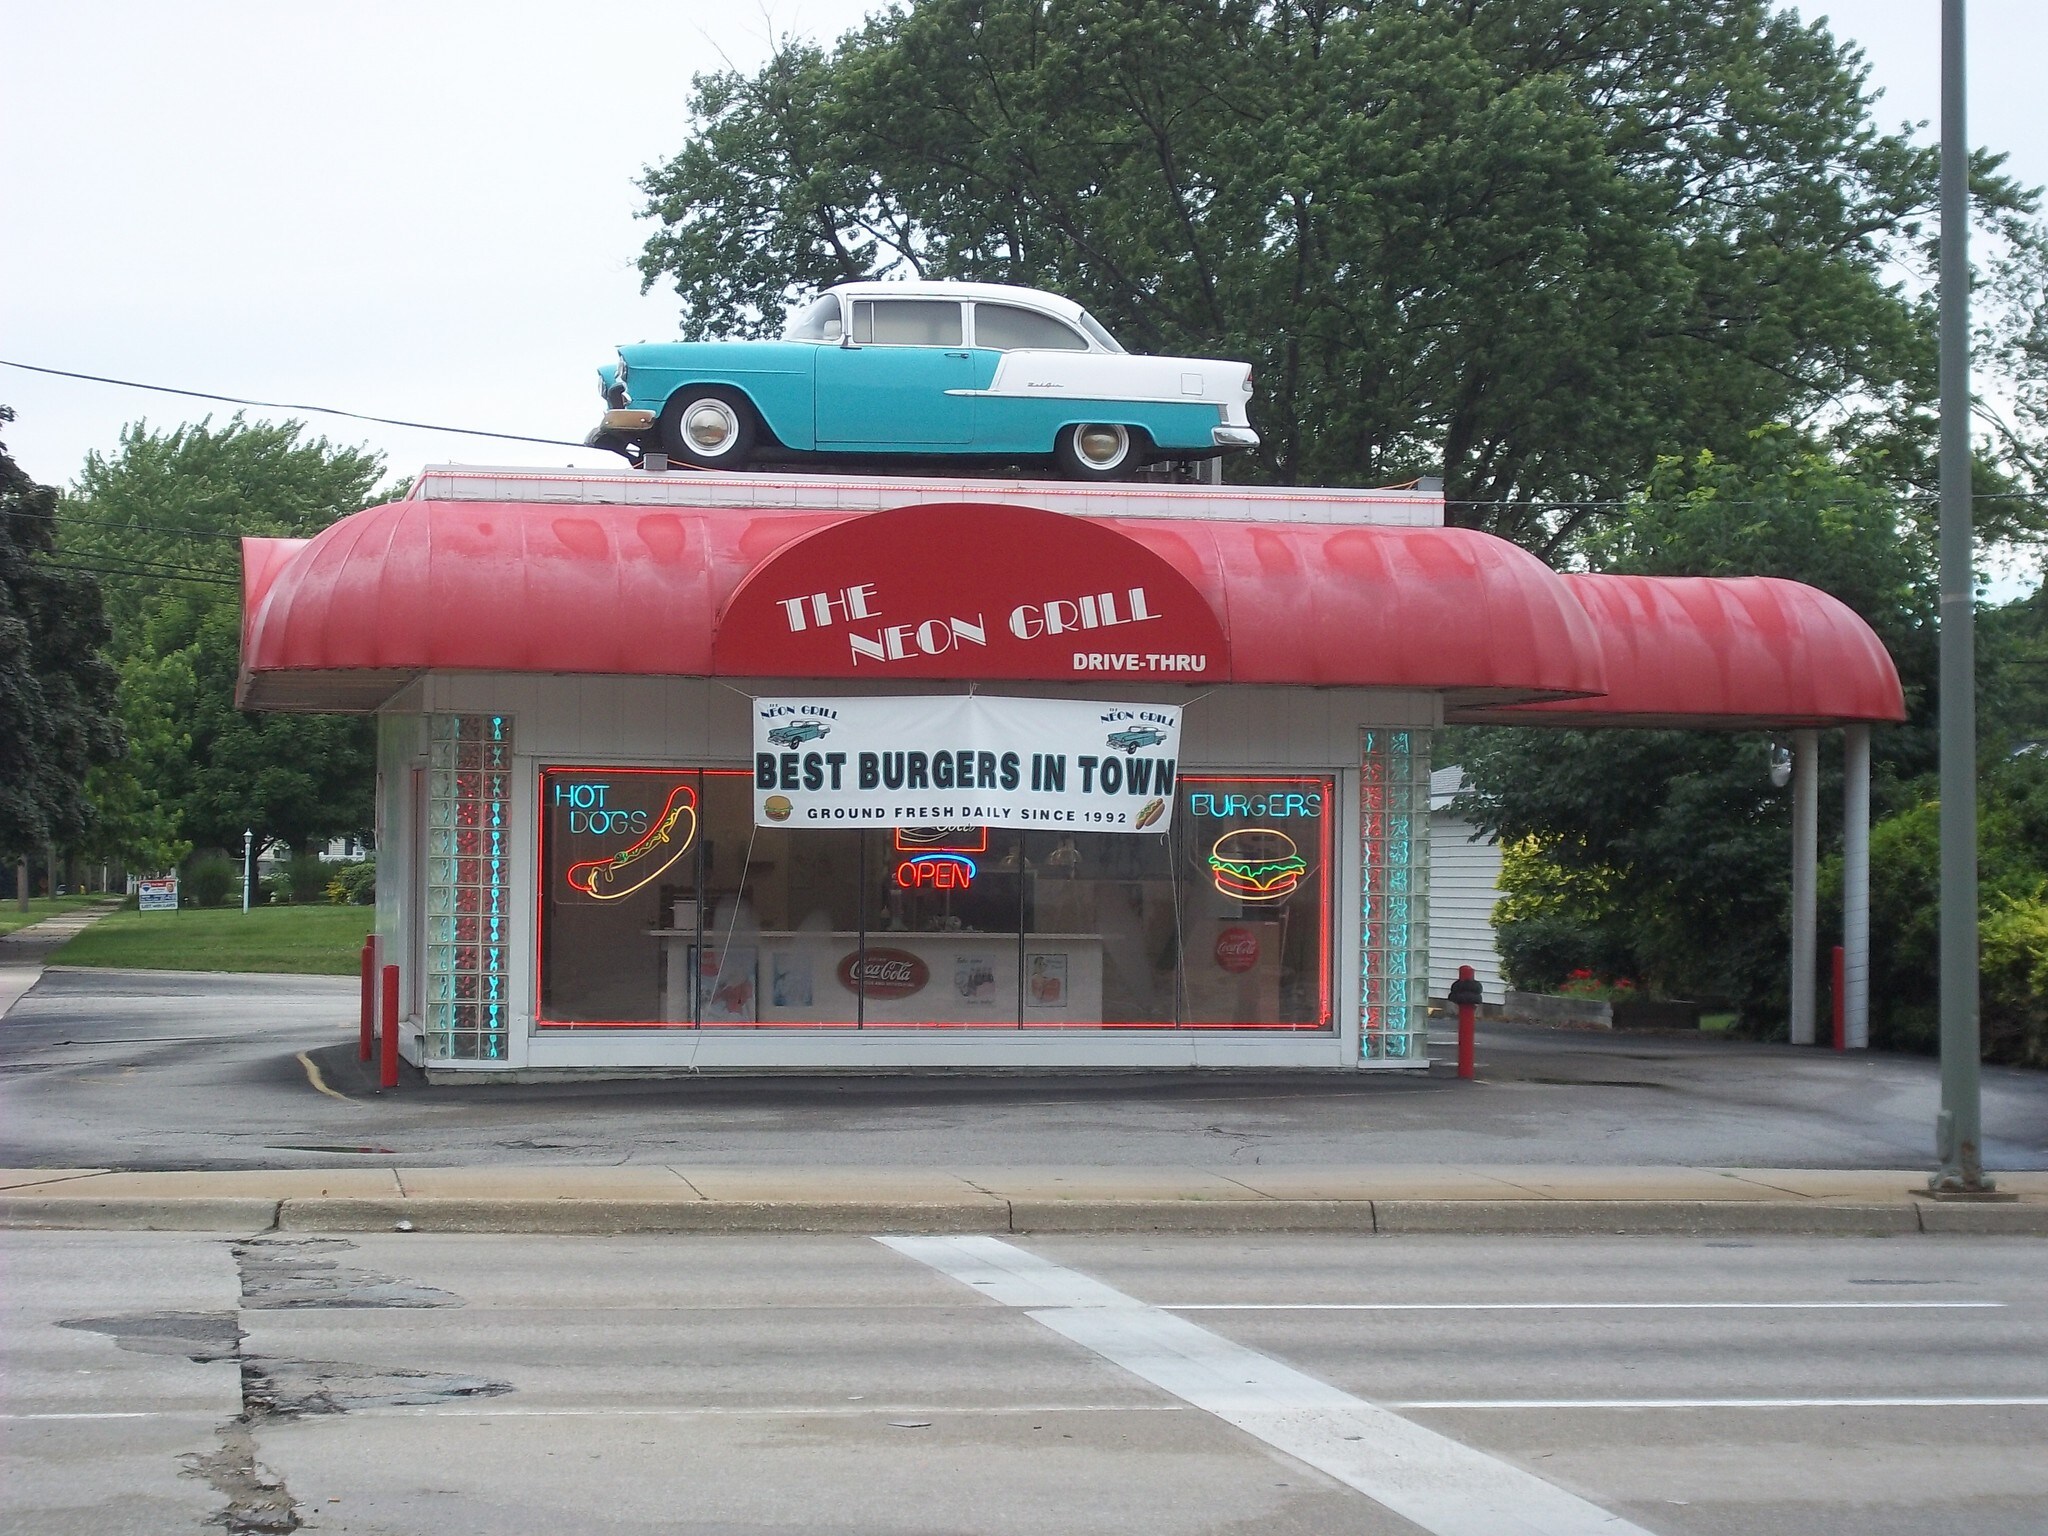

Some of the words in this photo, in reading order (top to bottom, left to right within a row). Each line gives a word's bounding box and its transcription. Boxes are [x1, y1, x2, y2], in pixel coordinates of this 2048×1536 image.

[776, 582, 882, 633] THE
[849, 612, 987, 667] NEON
[1009, 587, 1162, 640] GRILL
[1073, 653, 1206, 672] DRIVE-THRU
[760, 706, 796, 719] NEON
[801, 705, 839, 720] GRILL
[1100, 711, 1134, 724] NEON
[1140, 711, 1175, 728] GRILL
[756, 751, 847, 791] BEST
[858, 750, 1020, 791] BURGERS
[1031, 753, 1066, 792] IN
[1078, 756, 1175, 796] TOWN
[555, 784, 610, 808] HOT
[1191, 794, 1321, 817] BURGERS
[570, 810, 648, 834] DOGS
[807, 807, 885, 819] GROUND
[895, 806, 953, 818] FRESH
[962, 806, 1011, 818] DAILY
[1021, 808, 1075, 821] SINCE
[1084, 812, 1126, 823] 1992
[897, 862, 970, 888] OPEN
